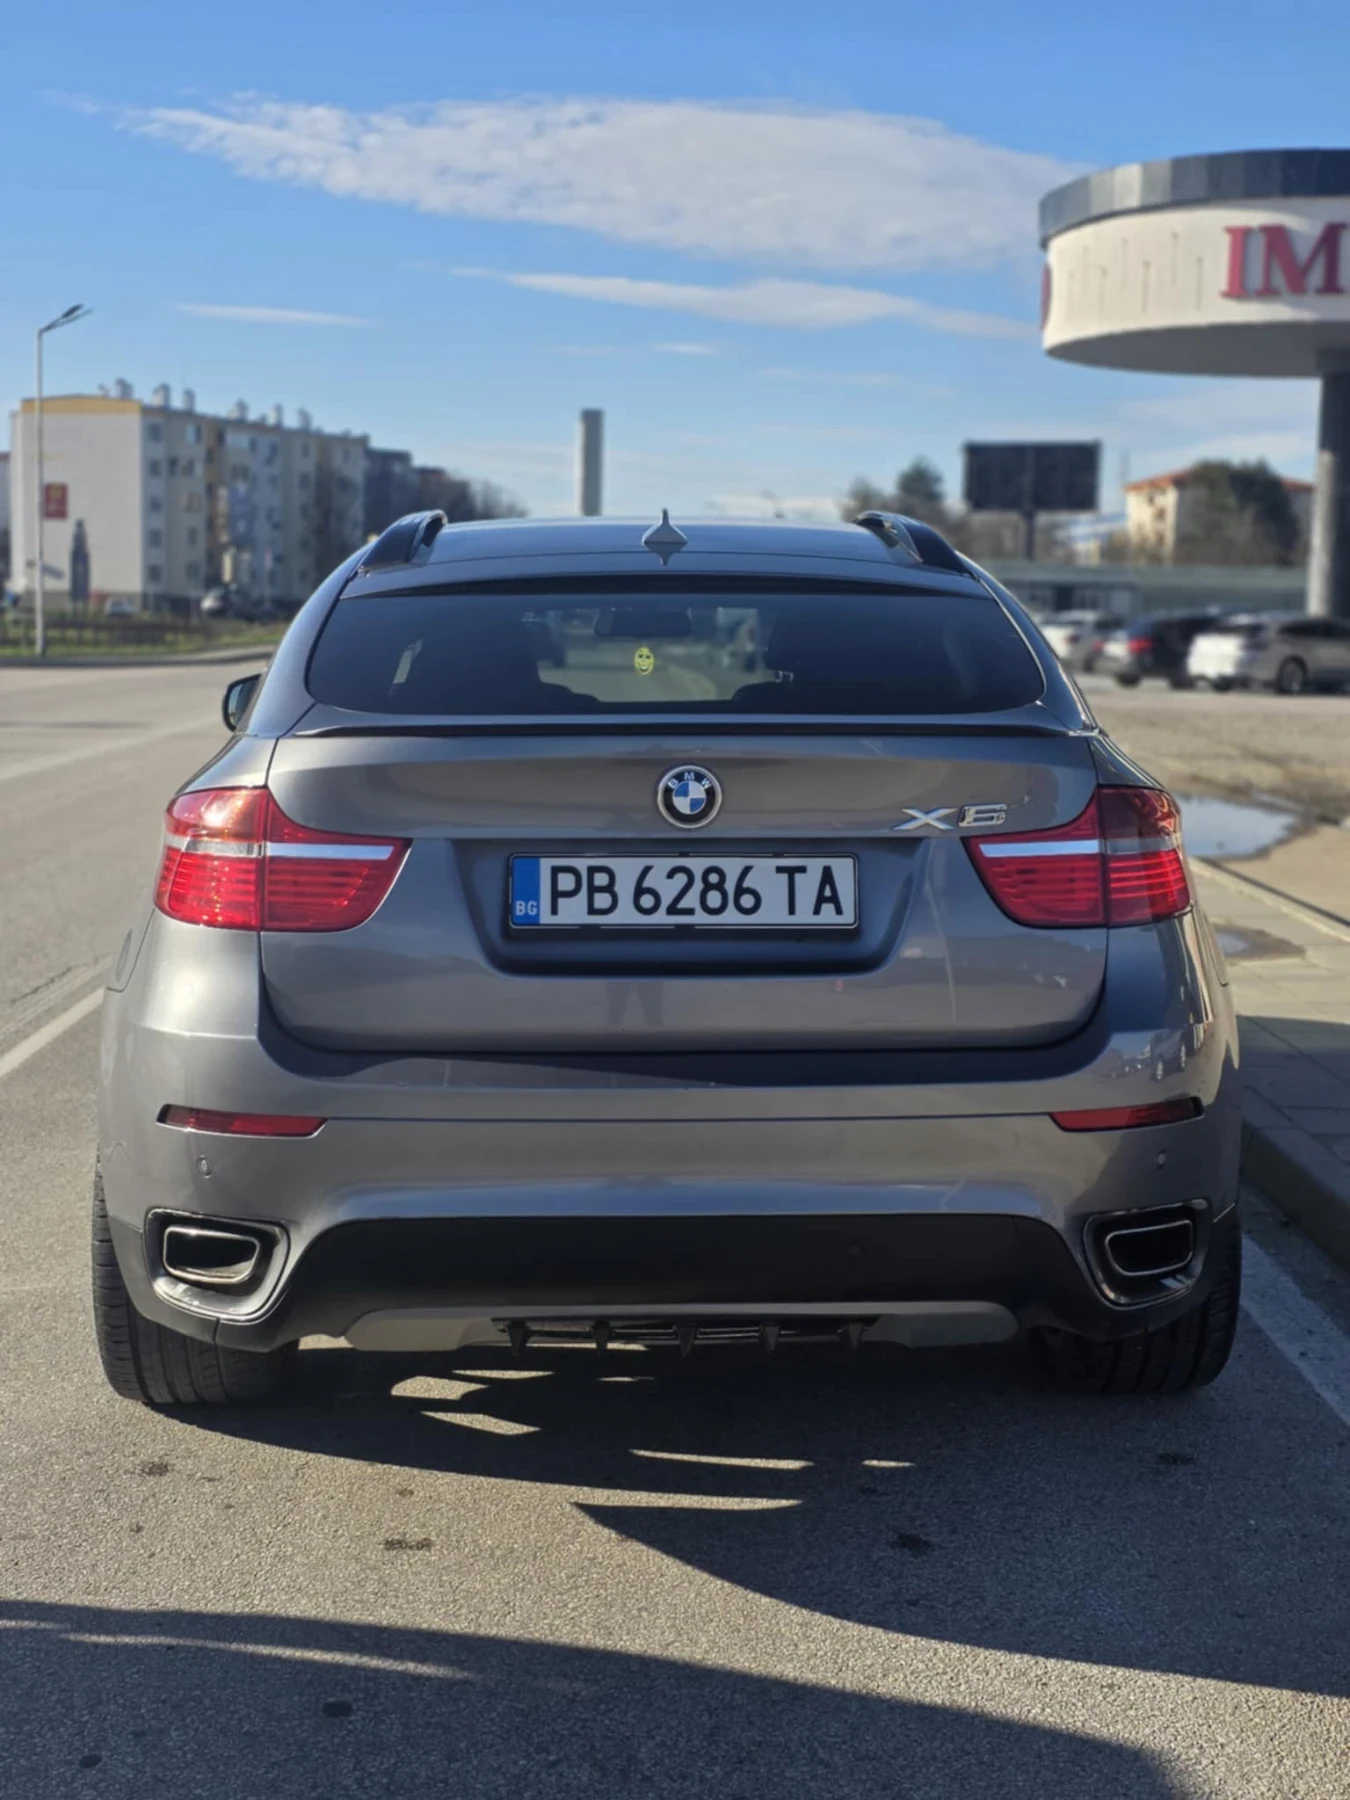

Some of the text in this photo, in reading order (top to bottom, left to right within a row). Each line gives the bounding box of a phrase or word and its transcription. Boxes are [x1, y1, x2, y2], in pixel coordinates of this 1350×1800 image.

[667, 771, 712, 789] BMW
[892, 803, 1008, 830] X6
[550, 865, 844, 916] PB 6286 TA
[515, 900, 538, 916] BG
